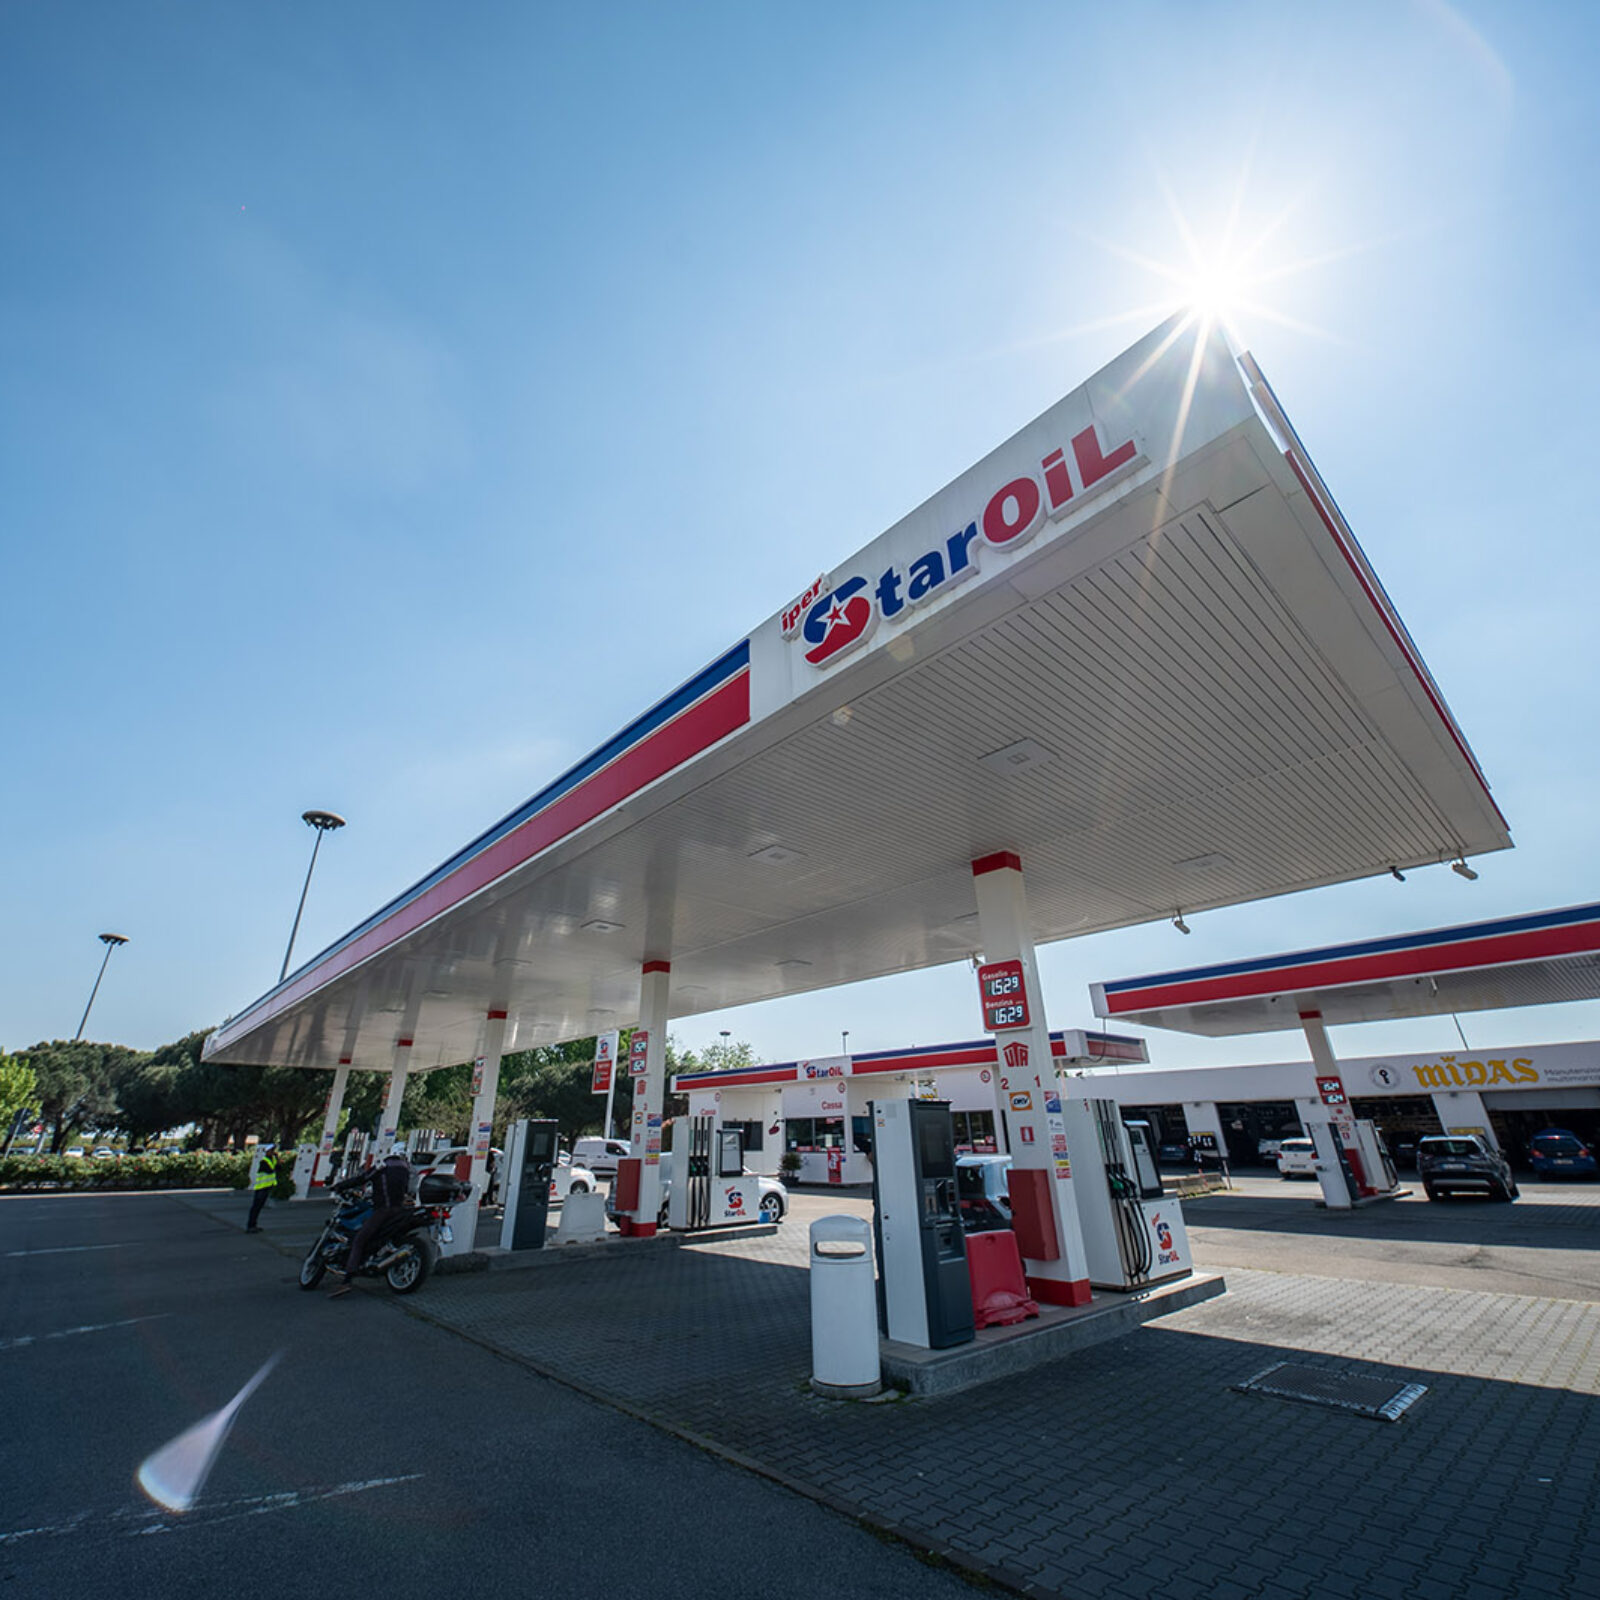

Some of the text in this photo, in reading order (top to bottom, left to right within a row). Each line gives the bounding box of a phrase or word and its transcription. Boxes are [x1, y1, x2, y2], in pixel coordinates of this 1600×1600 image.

[781, 576, 824, 634] iper
[982, 971, 1008, 980] Gasolio
[985, 1000, 1013, 1009] Benzina
[1003, 1041, 1029, 1067] UTA
[1000, 1075, 1041, 1090] 2 1
